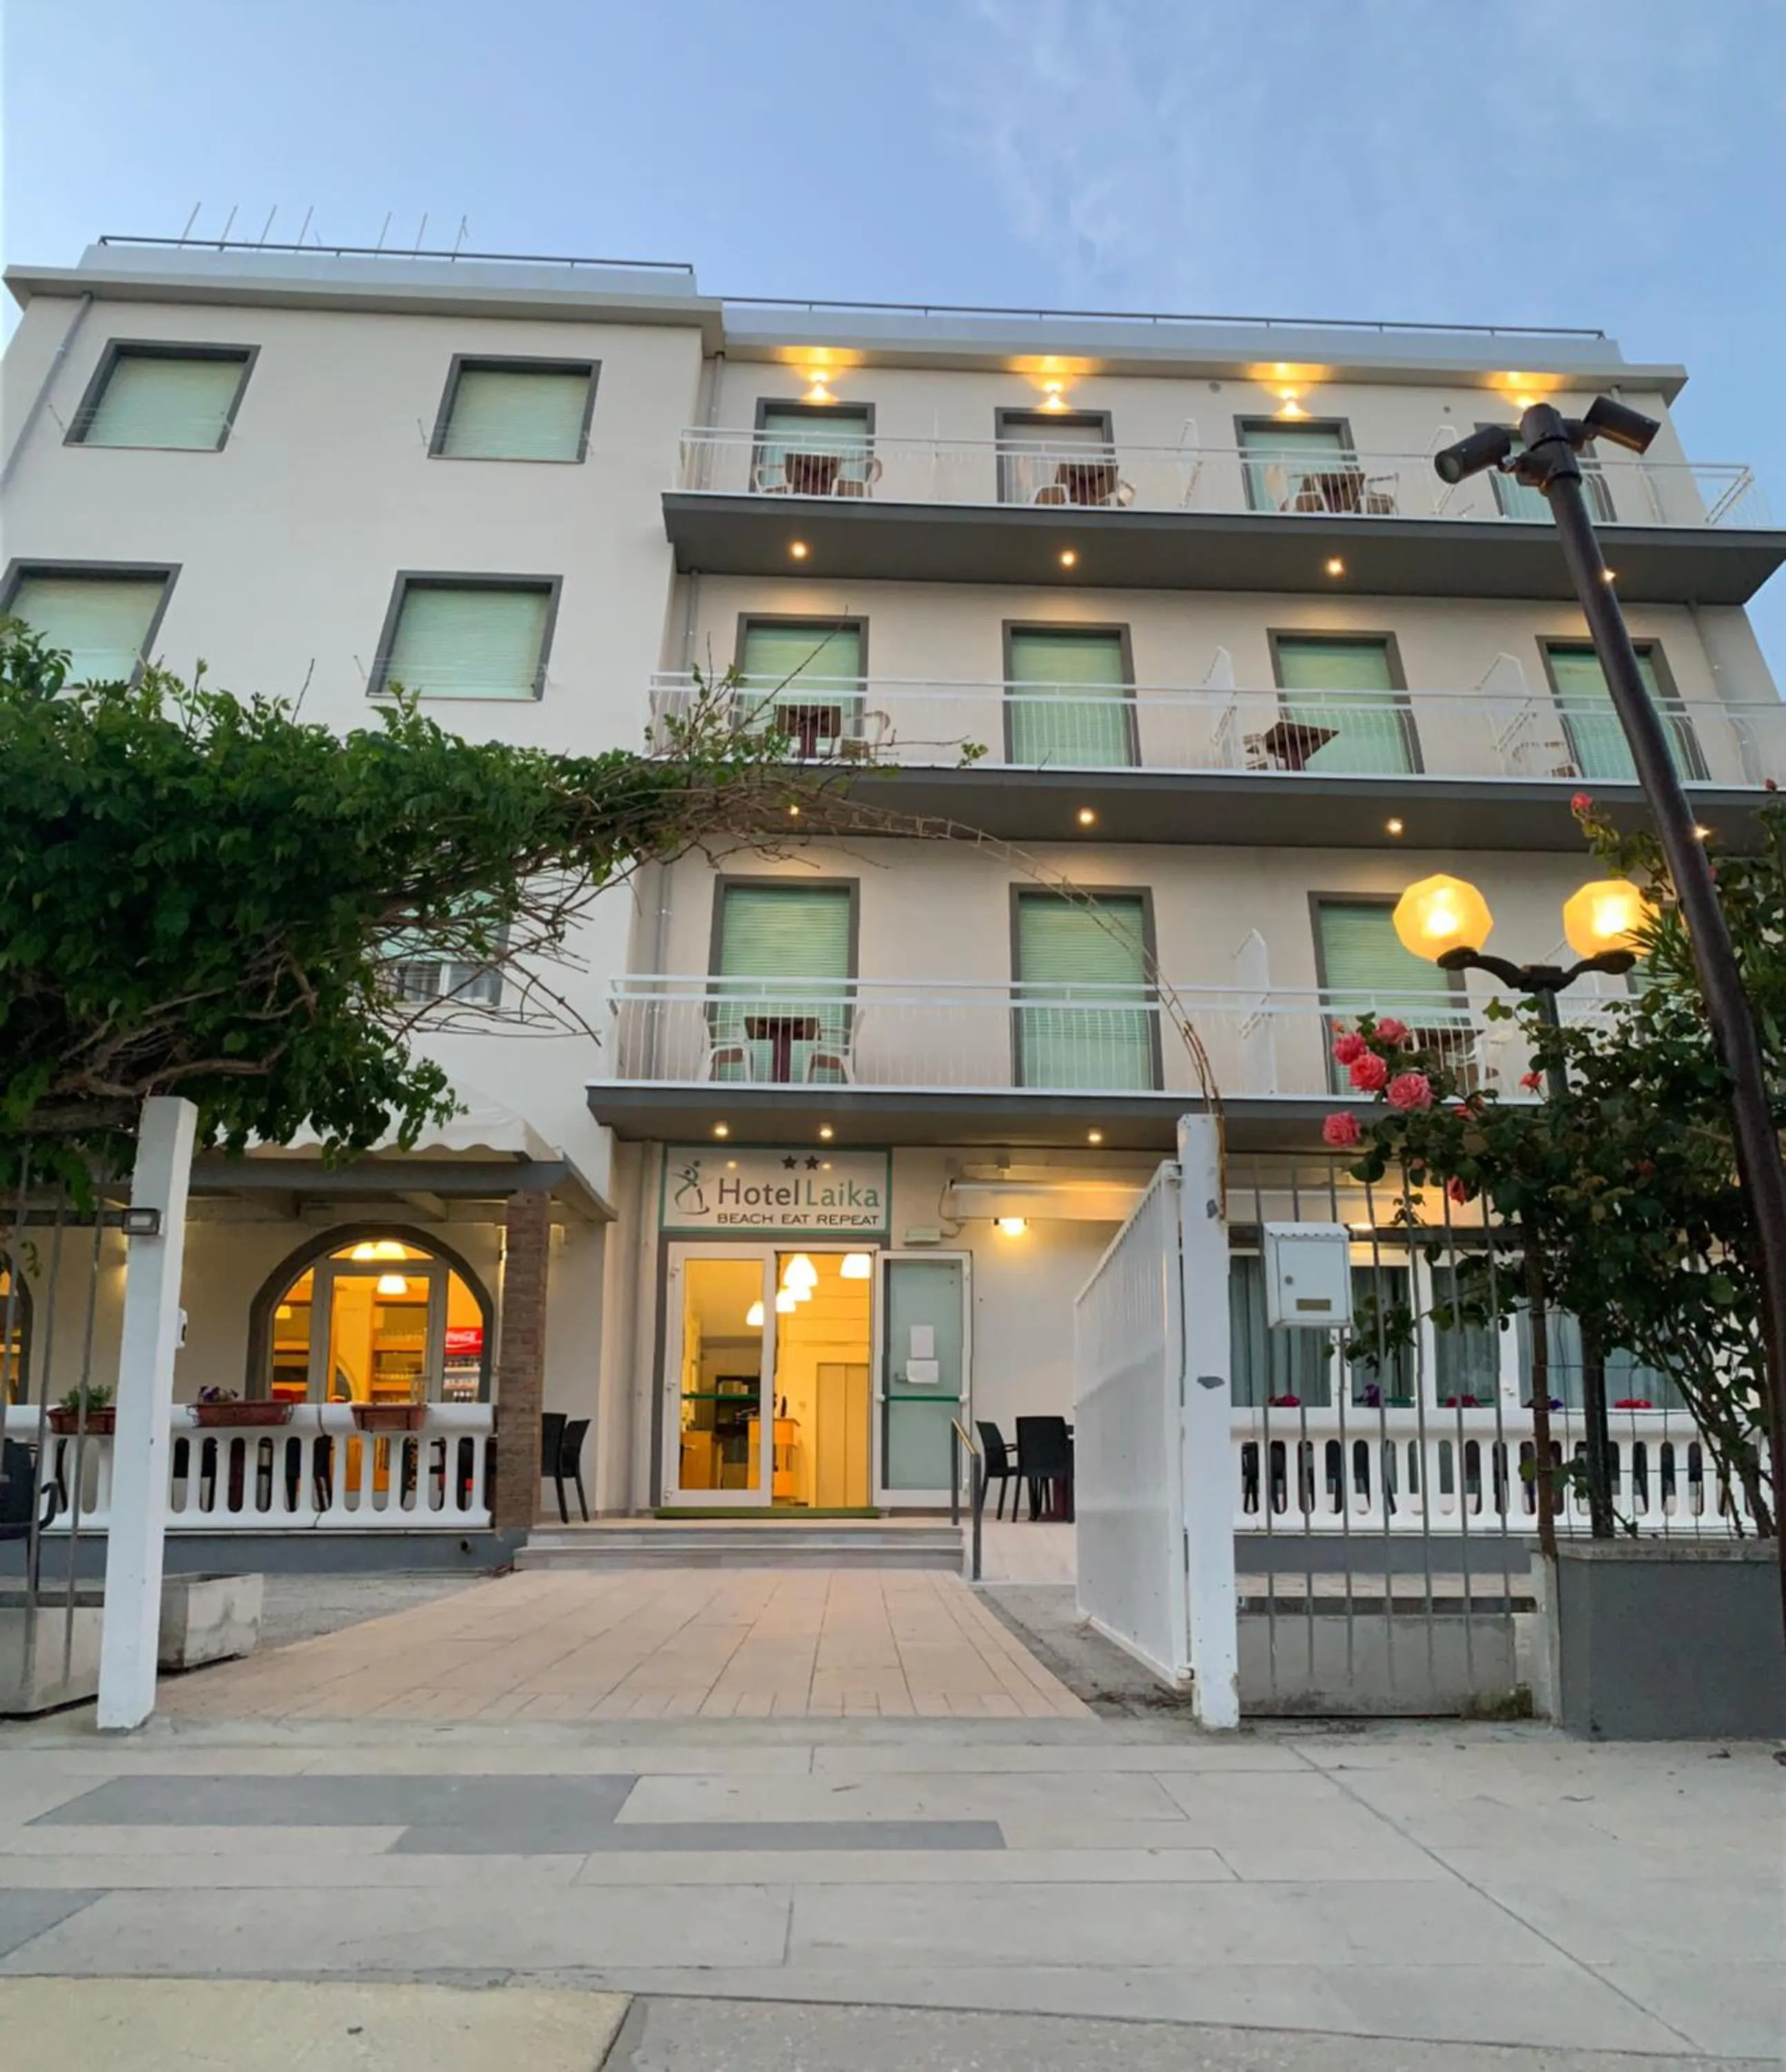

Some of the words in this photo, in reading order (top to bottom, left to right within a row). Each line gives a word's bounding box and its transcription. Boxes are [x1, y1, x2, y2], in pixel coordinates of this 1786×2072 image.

[718, 1178, 800, 1206] Hotel
[806, 1179, 880, 1207] Laika
[717, 1213, 774, 1224] BEACH
[780, 1214, 810, 1225] EAT
[816, 1214, 880, 1225] REPEAT
